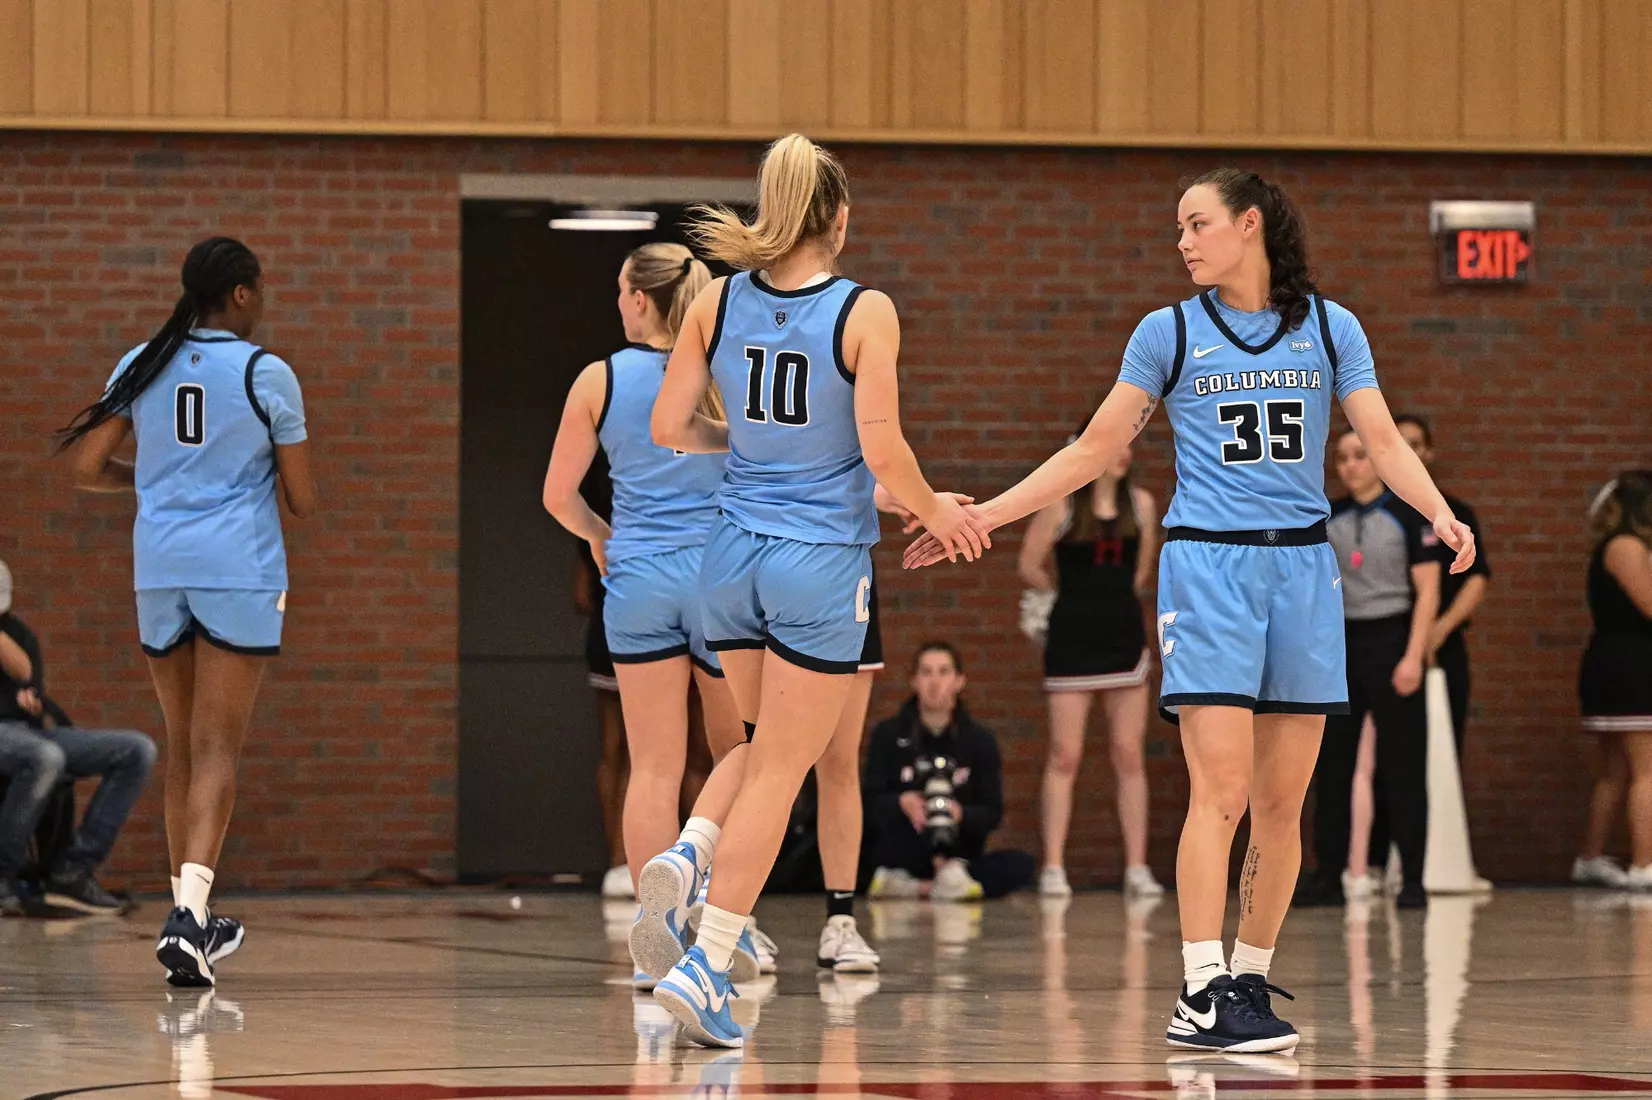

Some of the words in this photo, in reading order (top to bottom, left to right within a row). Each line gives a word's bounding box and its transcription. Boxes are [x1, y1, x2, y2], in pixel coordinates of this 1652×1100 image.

[1457, 229, 1519, 279] EXIT
[174, 382, 206, 448] 0
[743, 345, 811, 427] 10
[1193, 369, 1322, 397] COLUMBIA
[1216, 398, 1305, 466] 35
